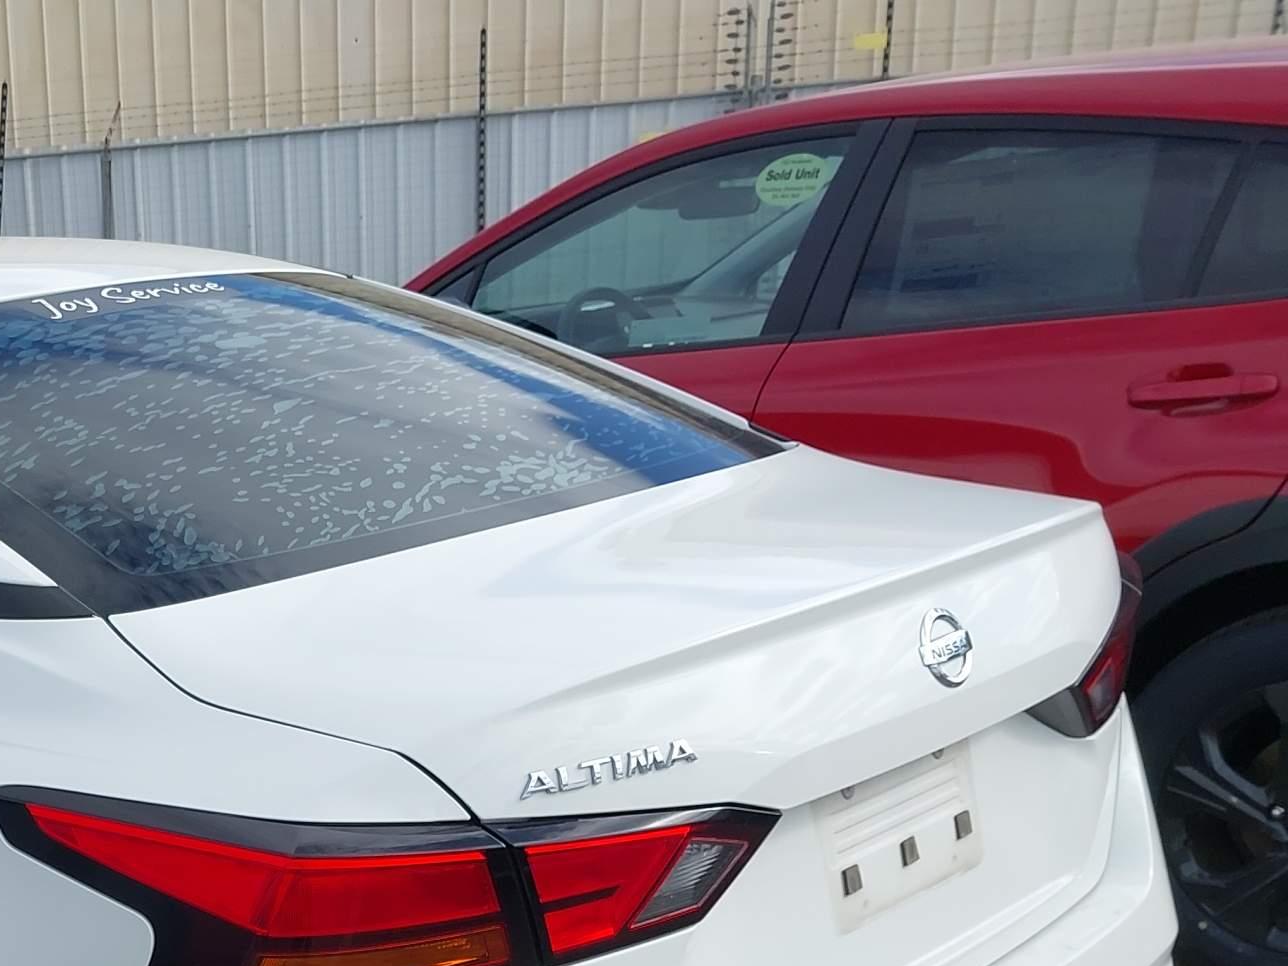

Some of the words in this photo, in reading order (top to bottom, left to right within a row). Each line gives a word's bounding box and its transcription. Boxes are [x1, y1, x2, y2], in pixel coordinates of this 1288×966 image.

[765, 168, 793, 182] Sold
[795, 167, 821, 180] Unit
[32, 297, 99, 320] Joy
[100, 281, 225, 304] Service
[520, 738, 698, 801] ALTIMA
